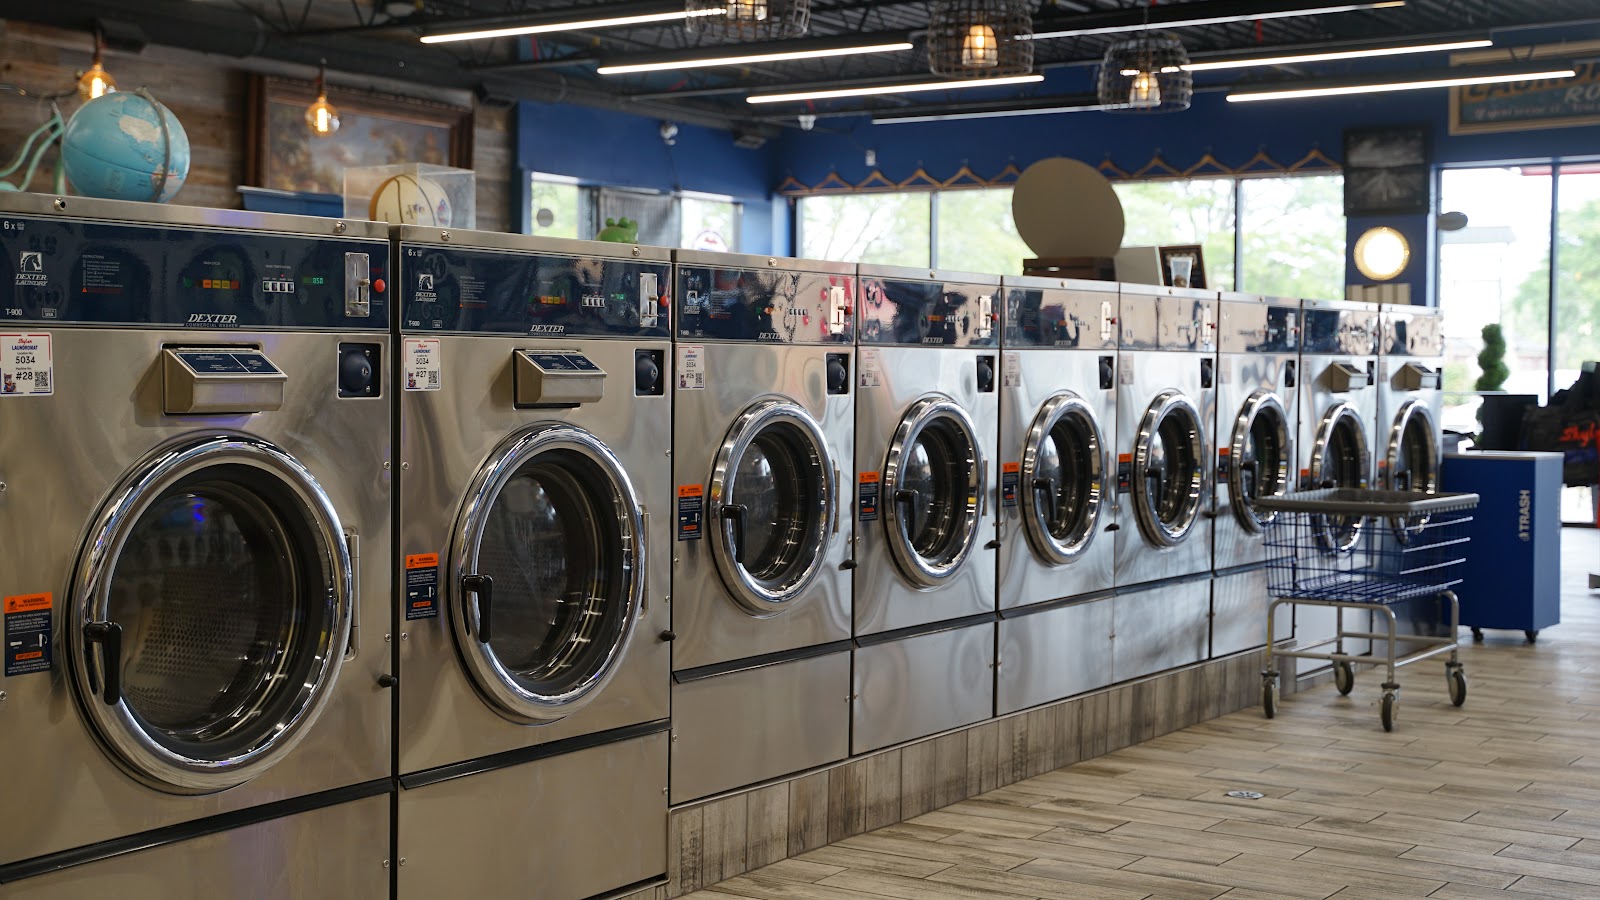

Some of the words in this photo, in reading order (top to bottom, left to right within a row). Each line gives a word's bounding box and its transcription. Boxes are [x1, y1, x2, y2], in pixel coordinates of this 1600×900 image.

[3, 221, 9, 230] 6
[408, 248, 412, 256] 6
[188, 314, 237, 323] DEXTER
[16, 356, 35, 364] 5034
[16, 372, 33, 380] #28
[1518, 490, 1530, 532] TRASH
